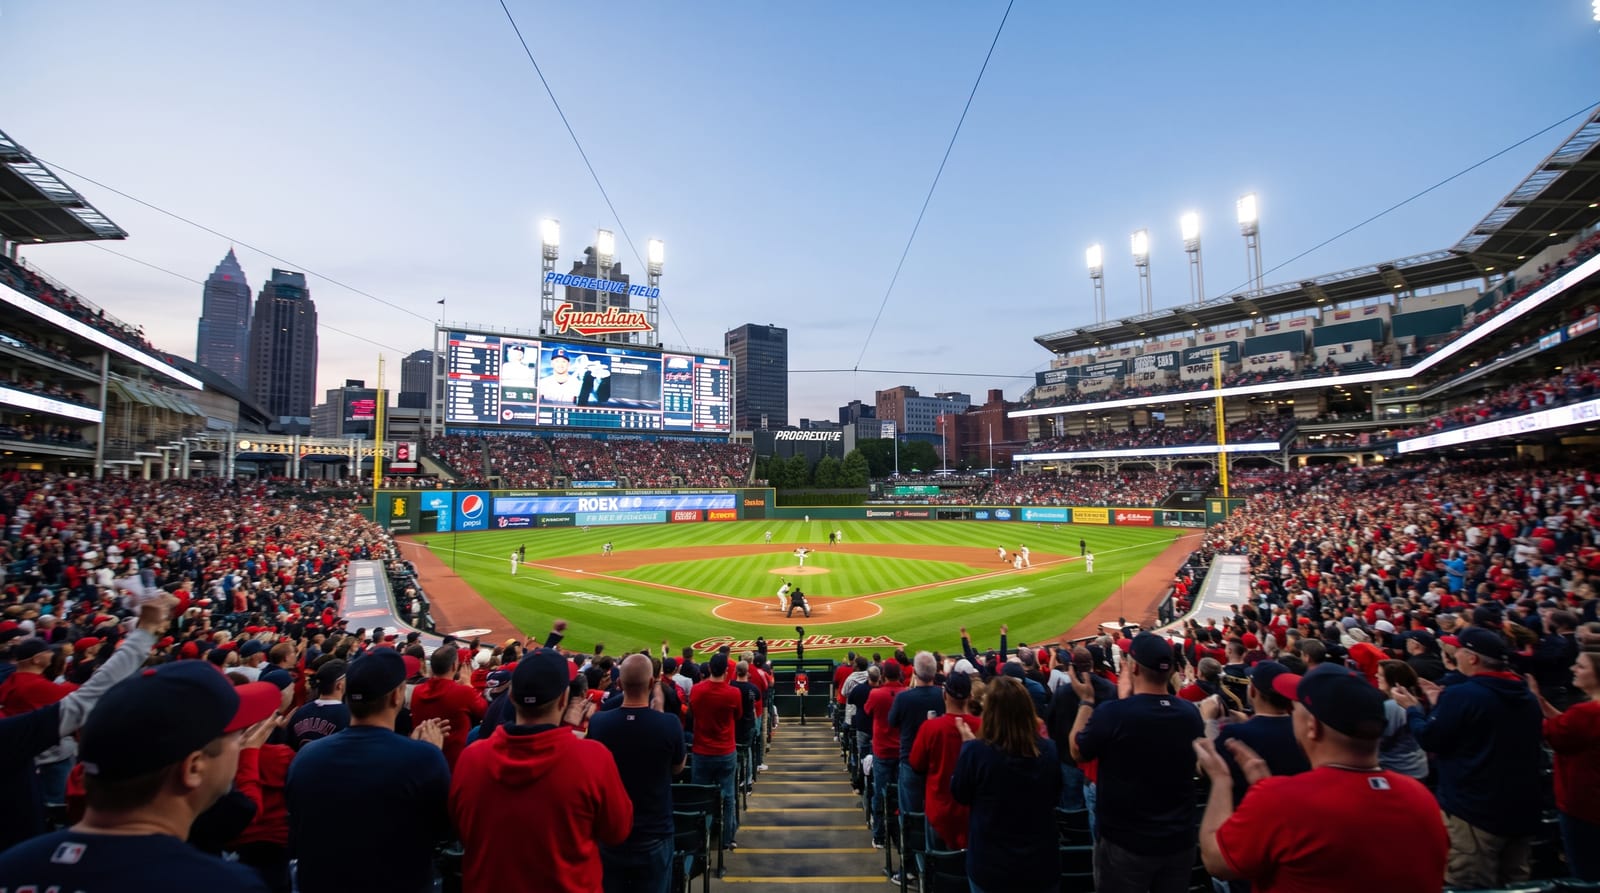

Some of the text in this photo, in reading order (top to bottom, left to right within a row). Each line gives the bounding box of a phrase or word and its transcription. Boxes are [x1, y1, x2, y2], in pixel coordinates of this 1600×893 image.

[544, 272, 661, 298] PROGRESSIVE FIELD
[553, 303, 655, 335] Guardians
[775, 430, 843, 441] PROGRESSIVE
[578, 497, 618, 511] ROEX
[463, 520, 482, 528] pepsi
